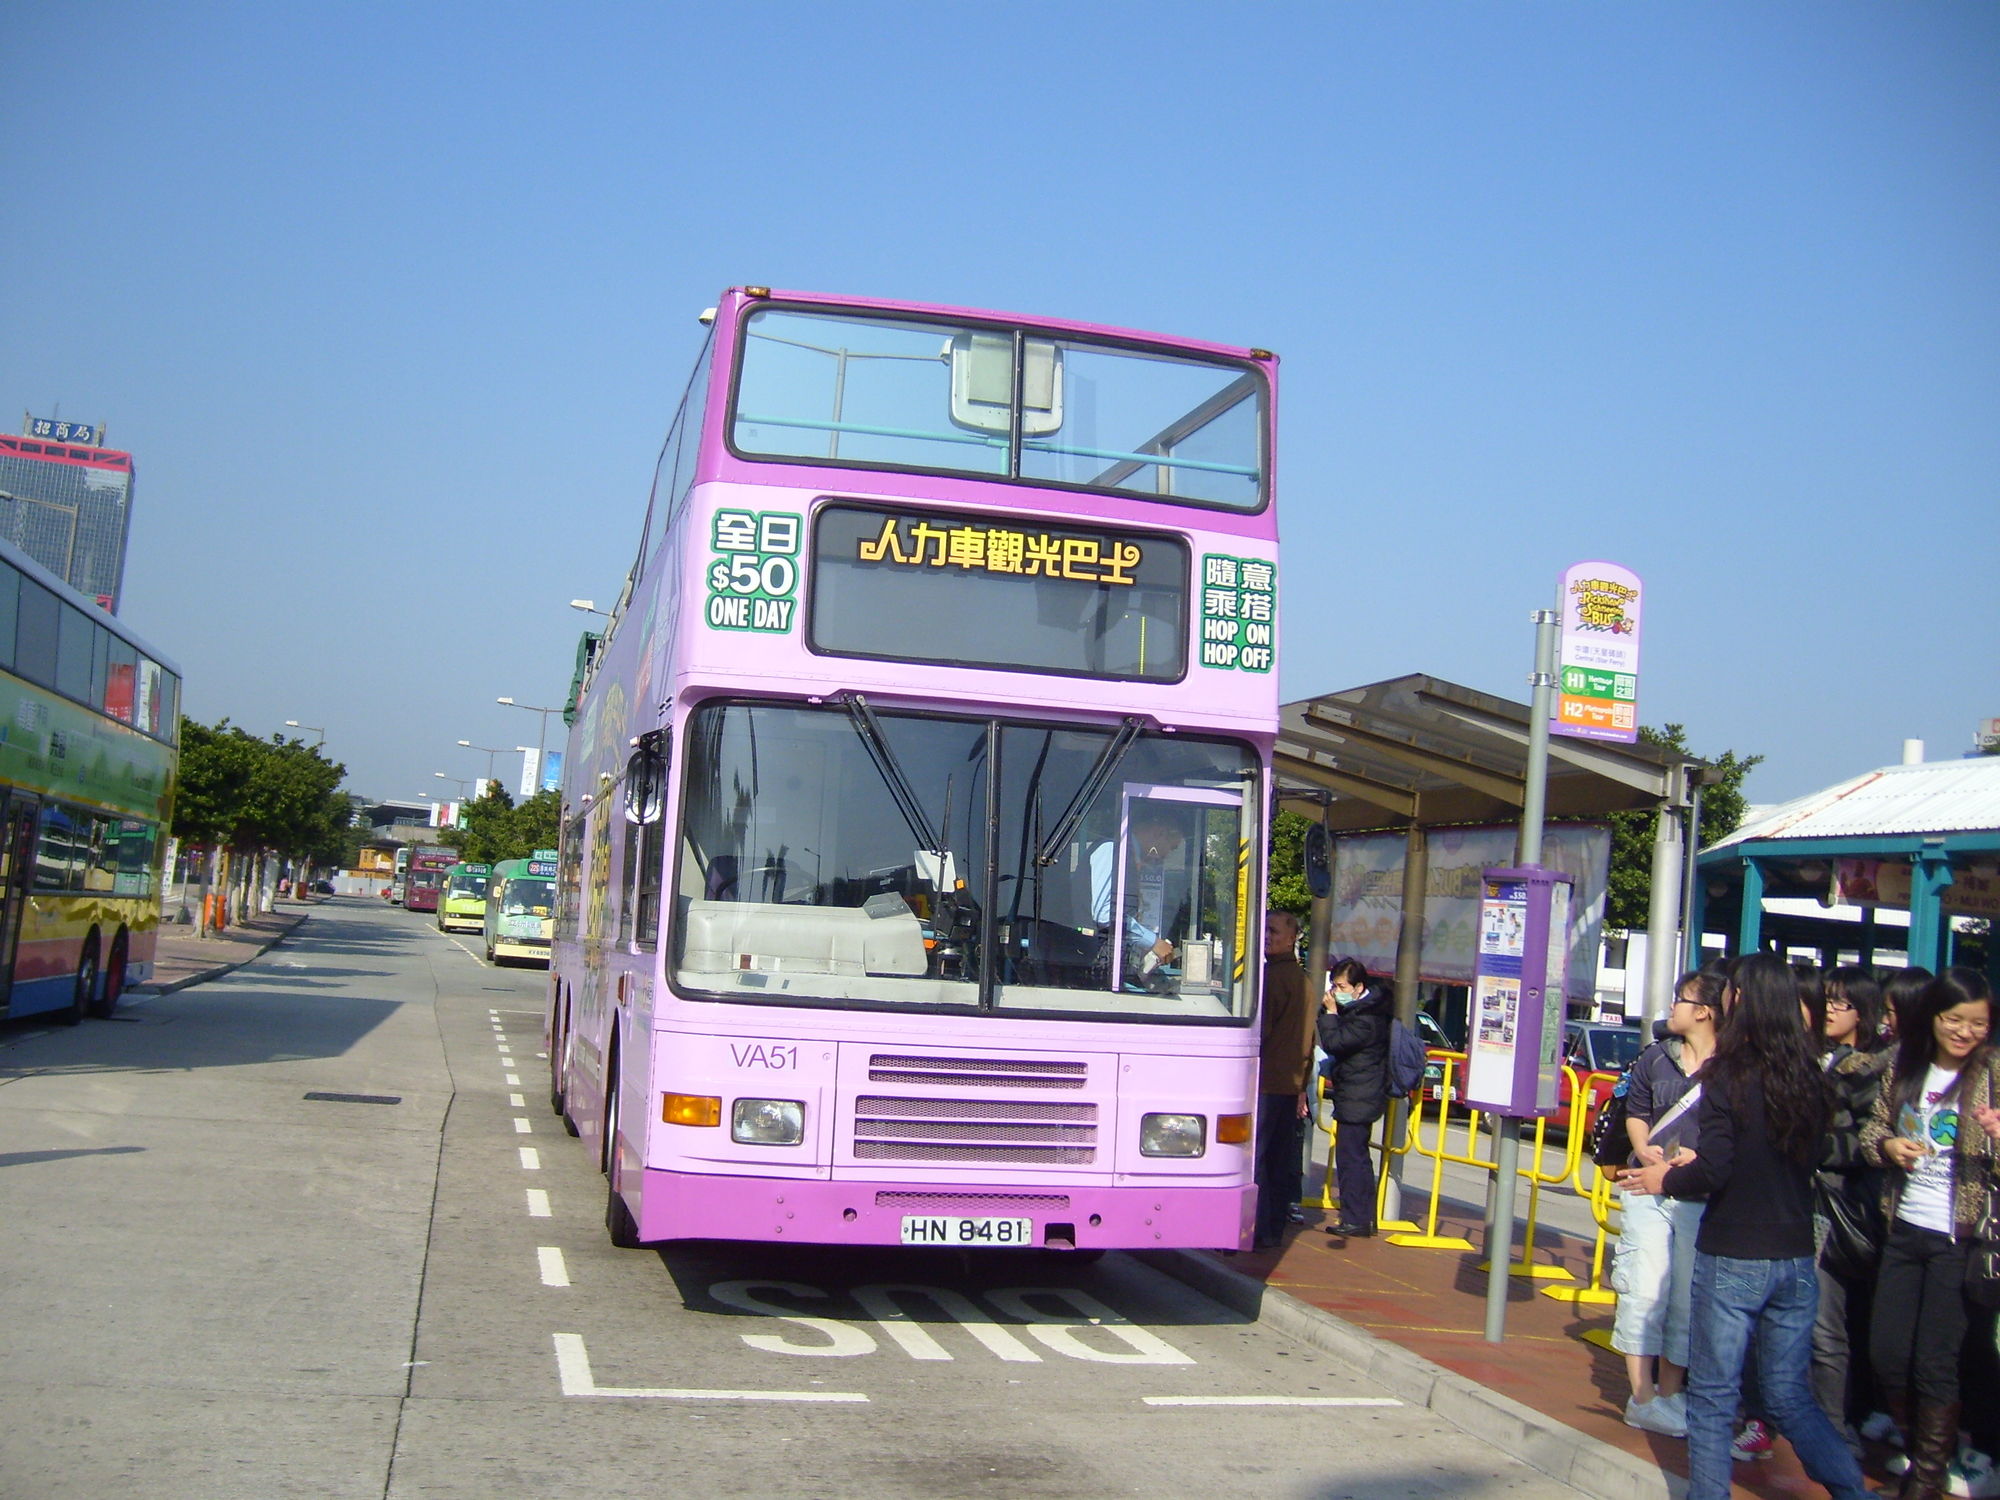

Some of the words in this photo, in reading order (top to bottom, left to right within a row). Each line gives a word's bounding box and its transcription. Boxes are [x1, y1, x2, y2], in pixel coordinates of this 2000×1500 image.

[34, 420, 90, 441] 招商局
[716, 513, 798, 552] 全日
[859, 519, 1141, 585] 人力車觀光巴士
[711, 555, 793, 595] $50
[1205, 560, 1274, 591] 隨意
[1569, 578, 1639, 603] 人力車觀光巴士
[710, 597, 749, 628] ONE
[753, 598, 792, 631] DAY
[1592, 612, 1615, 627] BUS
[1204, 618, 1238, 643] HOP
[1247, 621, 1271, 646] ON
[1203, 643, 1237, 667] HOP
[1241, 645, 1272, 671] OFF
[1566, 672, 1585, 689] H1
[1564, 701, 1584, 718] H2
[1604, 1014, 1622, 1023] TAXI
[730, 1043, 798, 1070] VA51
[909, 1219, 948, 1243] HN
[957, 1220, 1025, 1244] 8481
